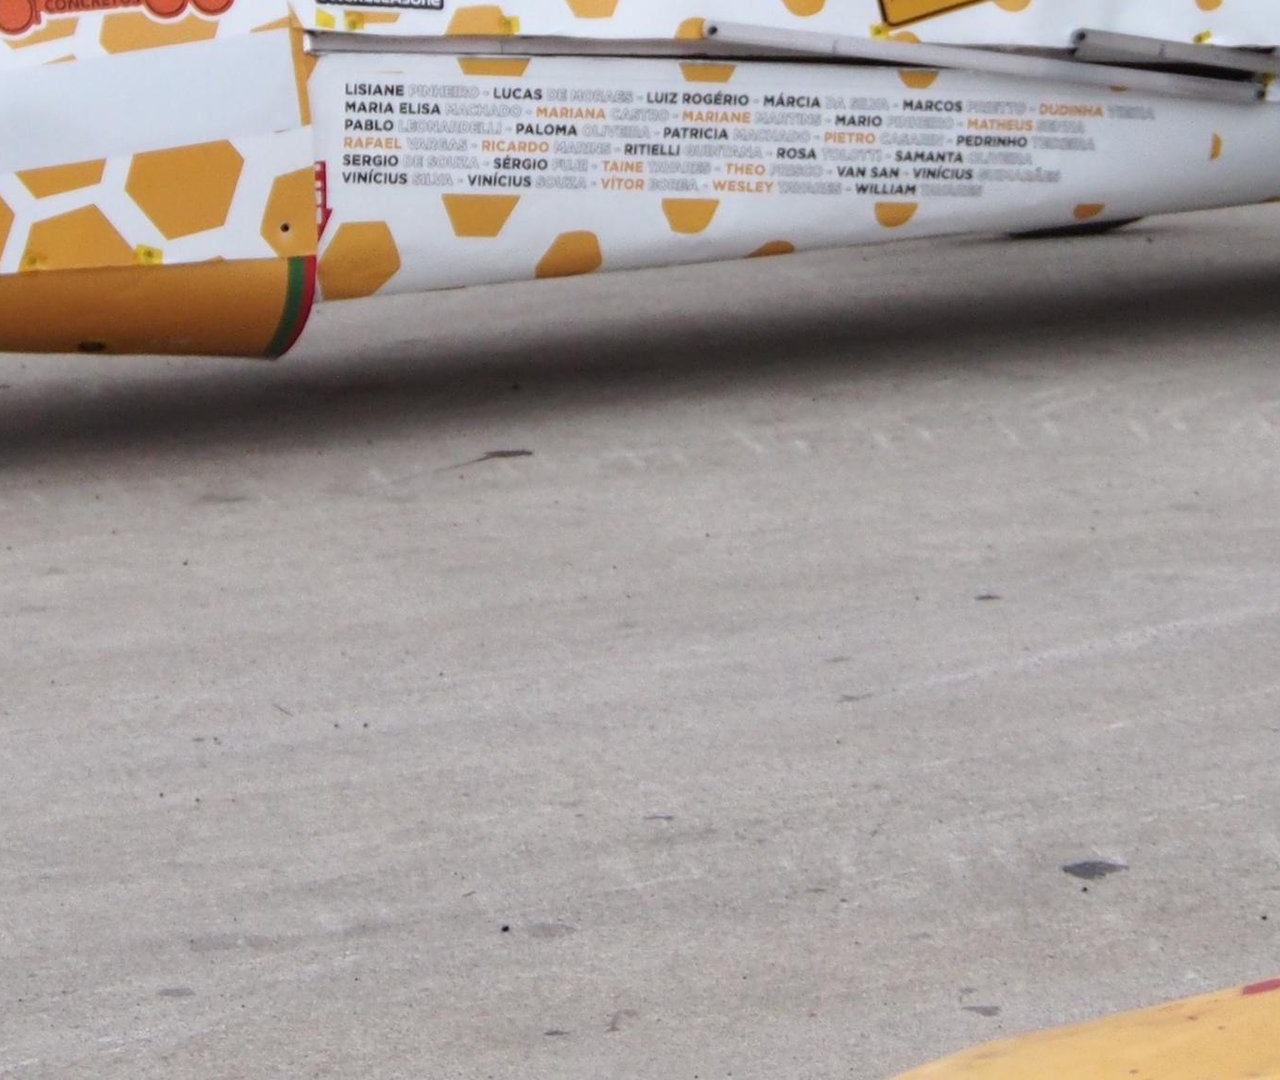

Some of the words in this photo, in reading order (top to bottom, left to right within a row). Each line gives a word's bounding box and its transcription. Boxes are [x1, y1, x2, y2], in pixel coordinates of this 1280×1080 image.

[344, 83, 405, 97] LISIANE
[493, 87, 543, 101] LUCAS
[646, 92, 678, 105] LUIZ
[682, 89, 750, 107] ROGÉRIO
[763, 92, 821, 108] MÁRCIA
[903, 100, 963, 113] MARCOS
[1038, 103, 1104, 117] DUDINHA
[344, 102, 394, 115] MARIA
[399, 103, 441, 116] ELISA
[536, 107, 606, 120] MARIANA
[682, 110, 751, 123] MARIANE
[834, 114, 882, 127] MARIO
[967, 118, 1033, 131] MATHEUS
[344, 119, 394, 132] PABLO
[515, 123, 578, 137] PALOMA
[663, 127, 729, 140] PATRICIA
[823, 131, 876, 144] PIETRO
[956, 135, 1028, 148] PEDRINHO
[343, 136, 402, 150] RAFAEL
[481, 139, 550, 153] RICARDO
[624, 143, 681, 156] RITIELLI
[776, 147, 817, 160] ROSA
[895, 150, 964, 163] SAMANTA
[342, 154, 399, 167] SERGIO
[493, 154, 549, 171] SÉRGIO
[602, 159, 644, 173] TAINE
[725, 162, 766, 176] THEO
[836, 165, 867, 178] VAN
[869, 166, 900, 179] SAN
[912, 164, 974, 180] VINÍCIUS
[341, 169, 408, 186] VINÍCIUS
[467, 172, 532, 188] VINÍCIUS
[601, 174, 645, 191] VÍTOR
[711, 180, 775, 194] WESLEY
[854, 182, 917, 196] WILLIAM
